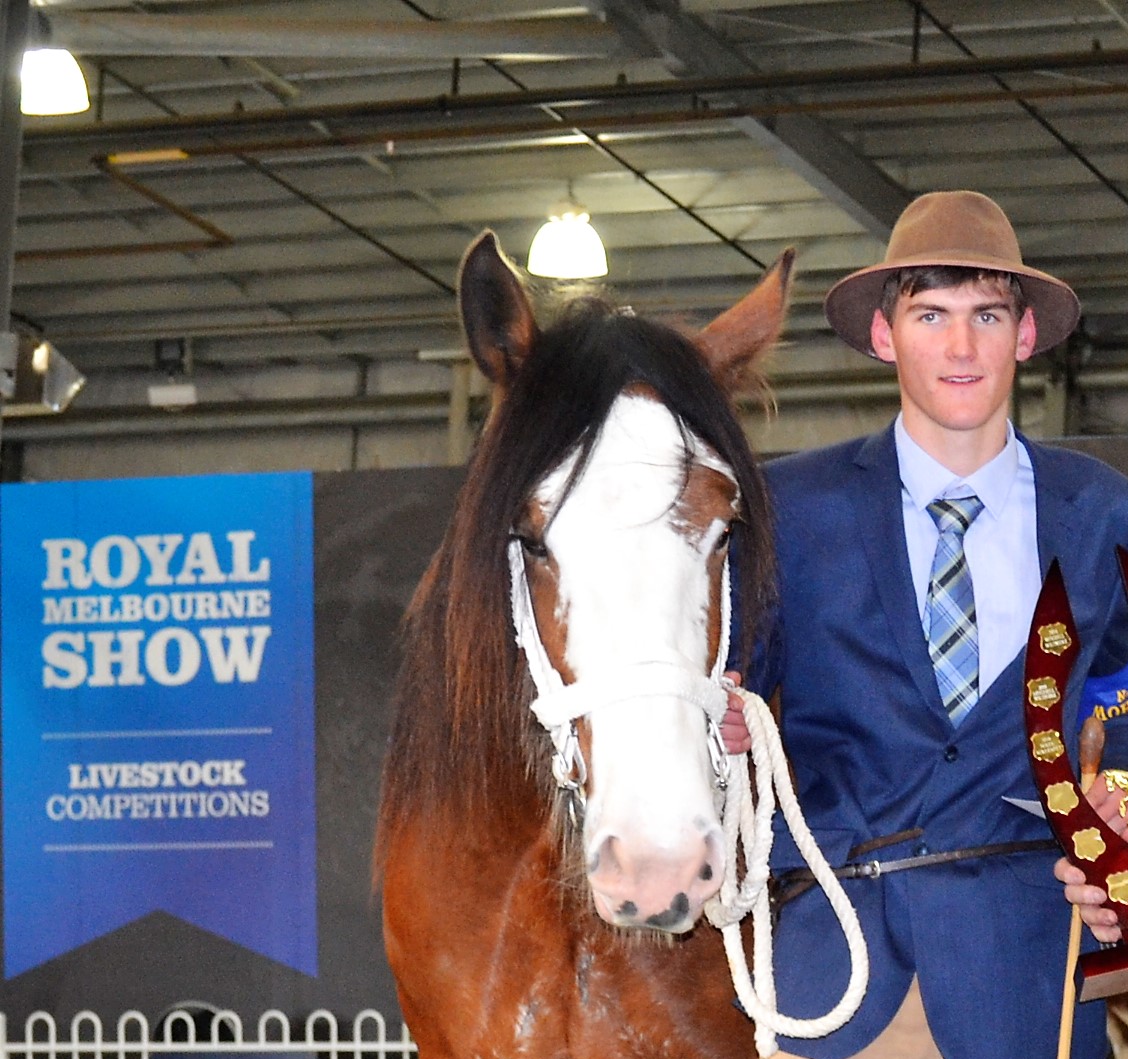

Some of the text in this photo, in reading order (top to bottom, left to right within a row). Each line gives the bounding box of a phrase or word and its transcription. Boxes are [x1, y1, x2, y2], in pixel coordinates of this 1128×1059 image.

[41, 531, 271, 590] ROYAL
[42, 590, 272, 625] MELBOURNE
[41, 626, 272, 689] SHOW
[69, 760, 247, 790] LIVESTOCK
[46, 791, 271, 821] COMPETITIONS
